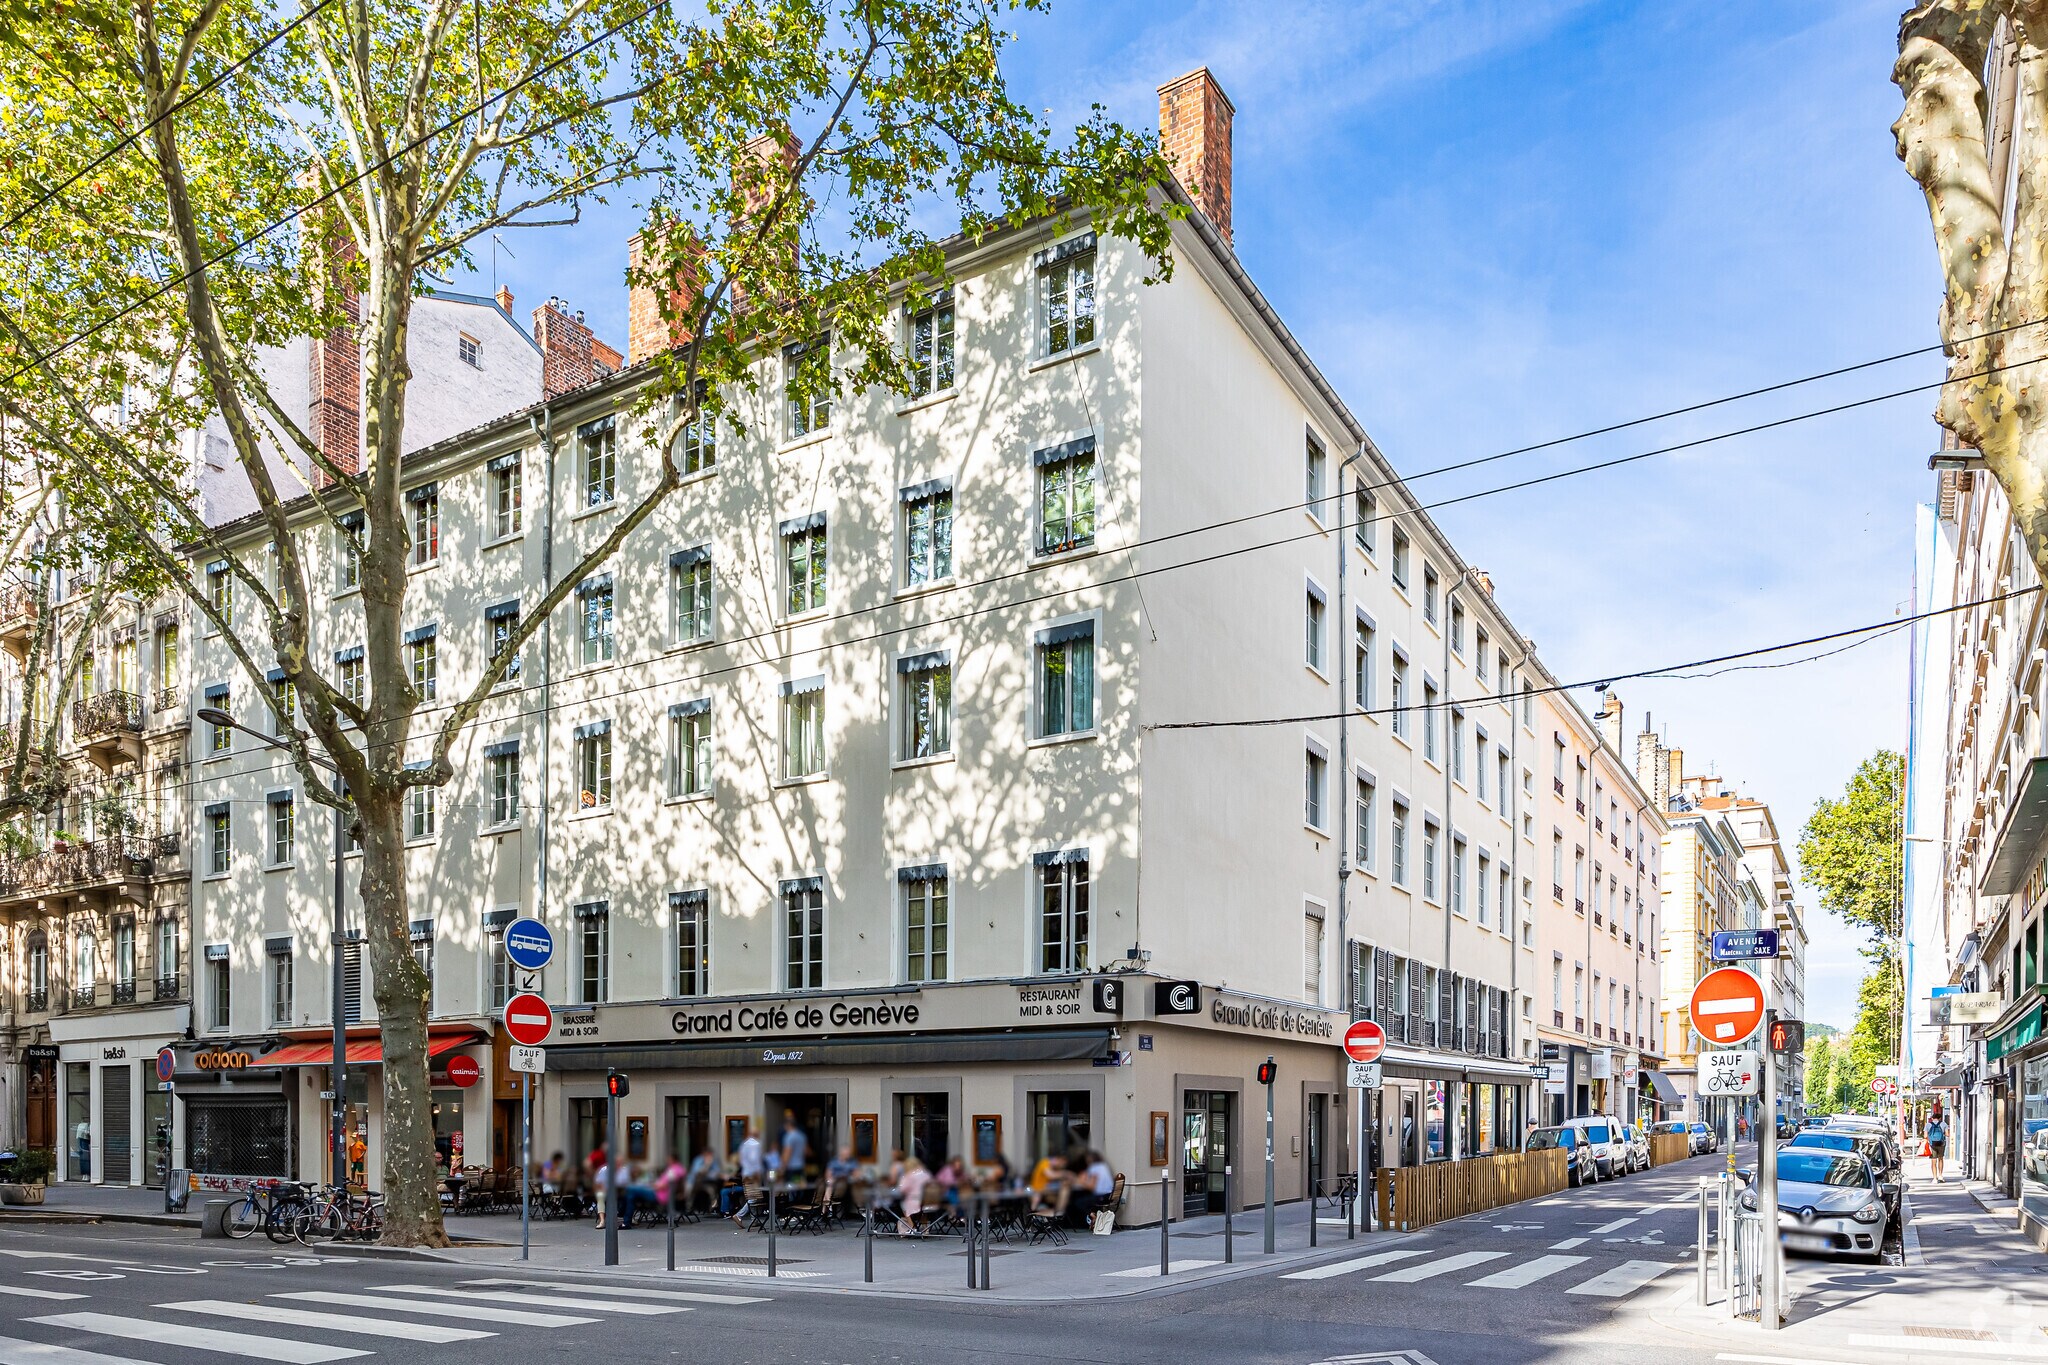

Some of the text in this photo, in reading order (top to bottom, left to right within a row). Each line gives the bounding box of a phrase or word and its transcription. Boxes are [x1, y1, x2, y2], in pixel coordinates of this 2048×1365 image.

[1728, 937, 1764, 946] AVENUE
[1754, 946, 1771, 955] SAXE
[1020, 989, 1081, 1002] RESTAURANT
[1019, 1003, 1081, 1017] MIDI & SOIR
[562, 1015, 596, 1025] BRASSERIE
[672, 1000, 919, 1034] Grand Café de Genève
[1213, 999, 1333, 1038] Grand Café de Genève
[560, 1026, 599, 1037] MIDI & SOIR
[30, 1048, 56, 1057] ba&sh
[103, 1047, 126, 1060] ba&sh
[518, 1049, 540, 1058] SAUF
[763, 1050, 803, 1064] Depuis 1872
[1711, 1054, 1743, 1066] SAUF
[452, 1067, 478, 1076] catimini
[1531, 1067, 1548, 1075] UBE
[23, 1260, 287, 1281] BUS
